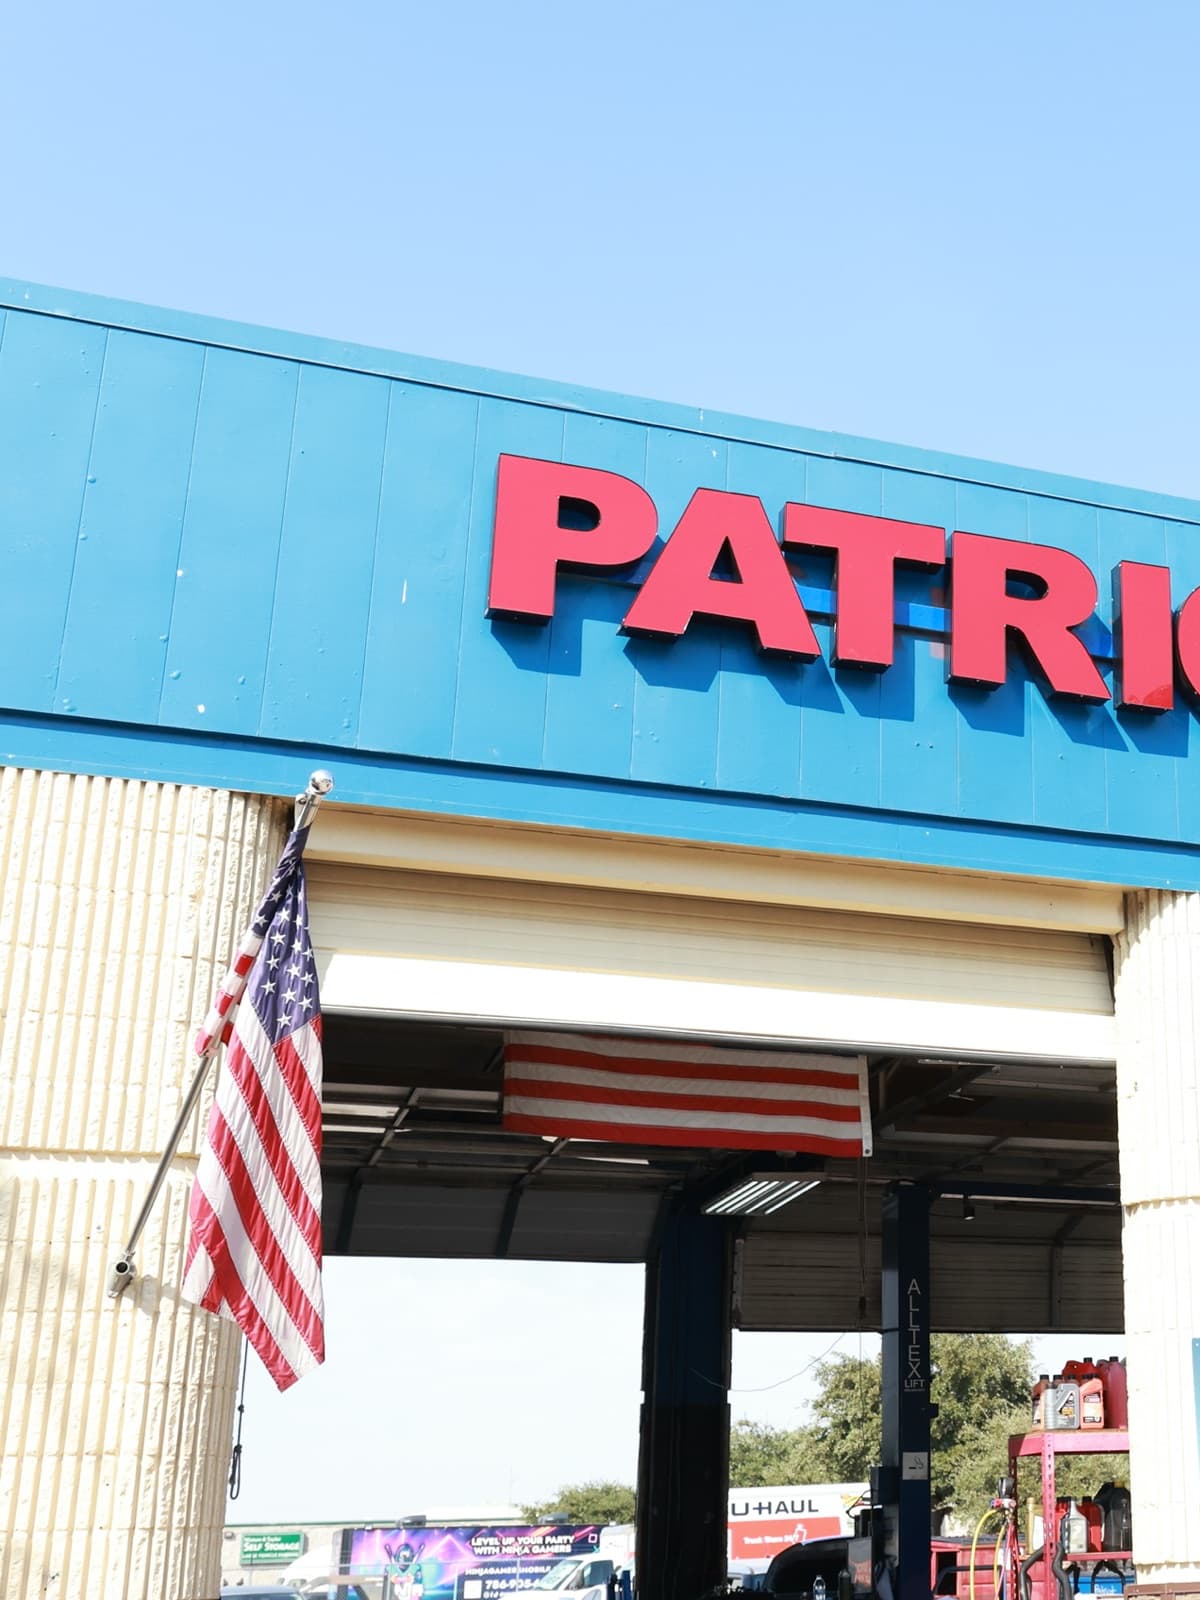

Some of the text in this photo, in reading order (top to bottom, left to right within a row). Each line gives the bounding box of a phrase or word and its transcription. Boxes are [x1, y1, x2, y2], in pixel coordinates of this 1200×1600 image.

[907, 1278, 921, 1379] ALLTEX
[904, 1379, 925, 1388] LIFT
[731, 1499, 819, 1516] U-HAUL
[471, 1535, 575, 1546] LEVEL UP YOUR PARTY
[243, 1541, 300, 1552] SELF STORAGE
[474, 1546, 500, 1555] WITH
[531, 1544, 572, 1553] GAMERS
